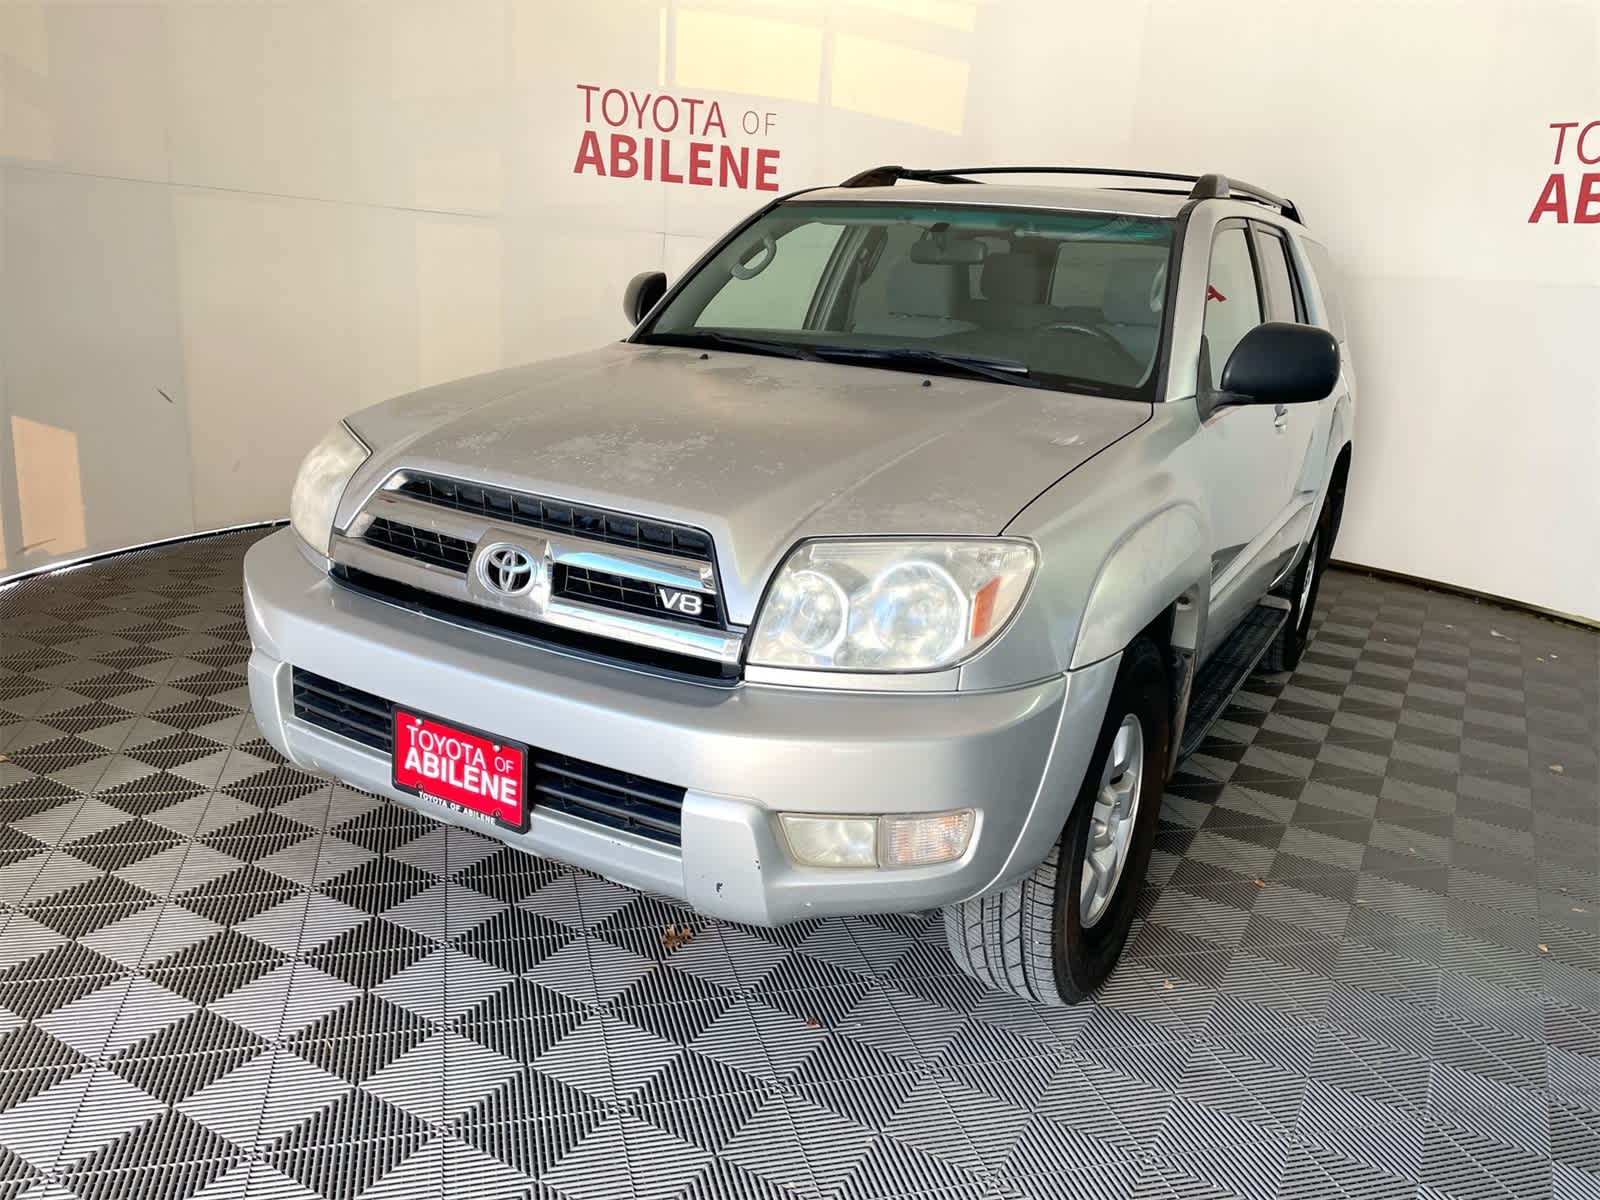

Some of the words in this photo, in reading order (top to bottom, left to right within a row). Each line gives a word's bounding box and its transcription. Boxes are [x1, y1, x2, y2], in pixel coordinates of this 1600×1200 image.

[577, 84, 727, 138] TOYOTA
[742, 110, 777, 136] OF
[573, 130, 780, 192] ABILENE
[659, 588, 702, 615] V8
[406, 725, 487, 769] TOYOTA
[494, 756, 514, 773] OF
[404, 746, 518, 806] ABILENE
[418, 791, 448, 808] TOYOTA
[450, 803, 460, 811] OF
[463, 808, 496, 825] ABILENE
